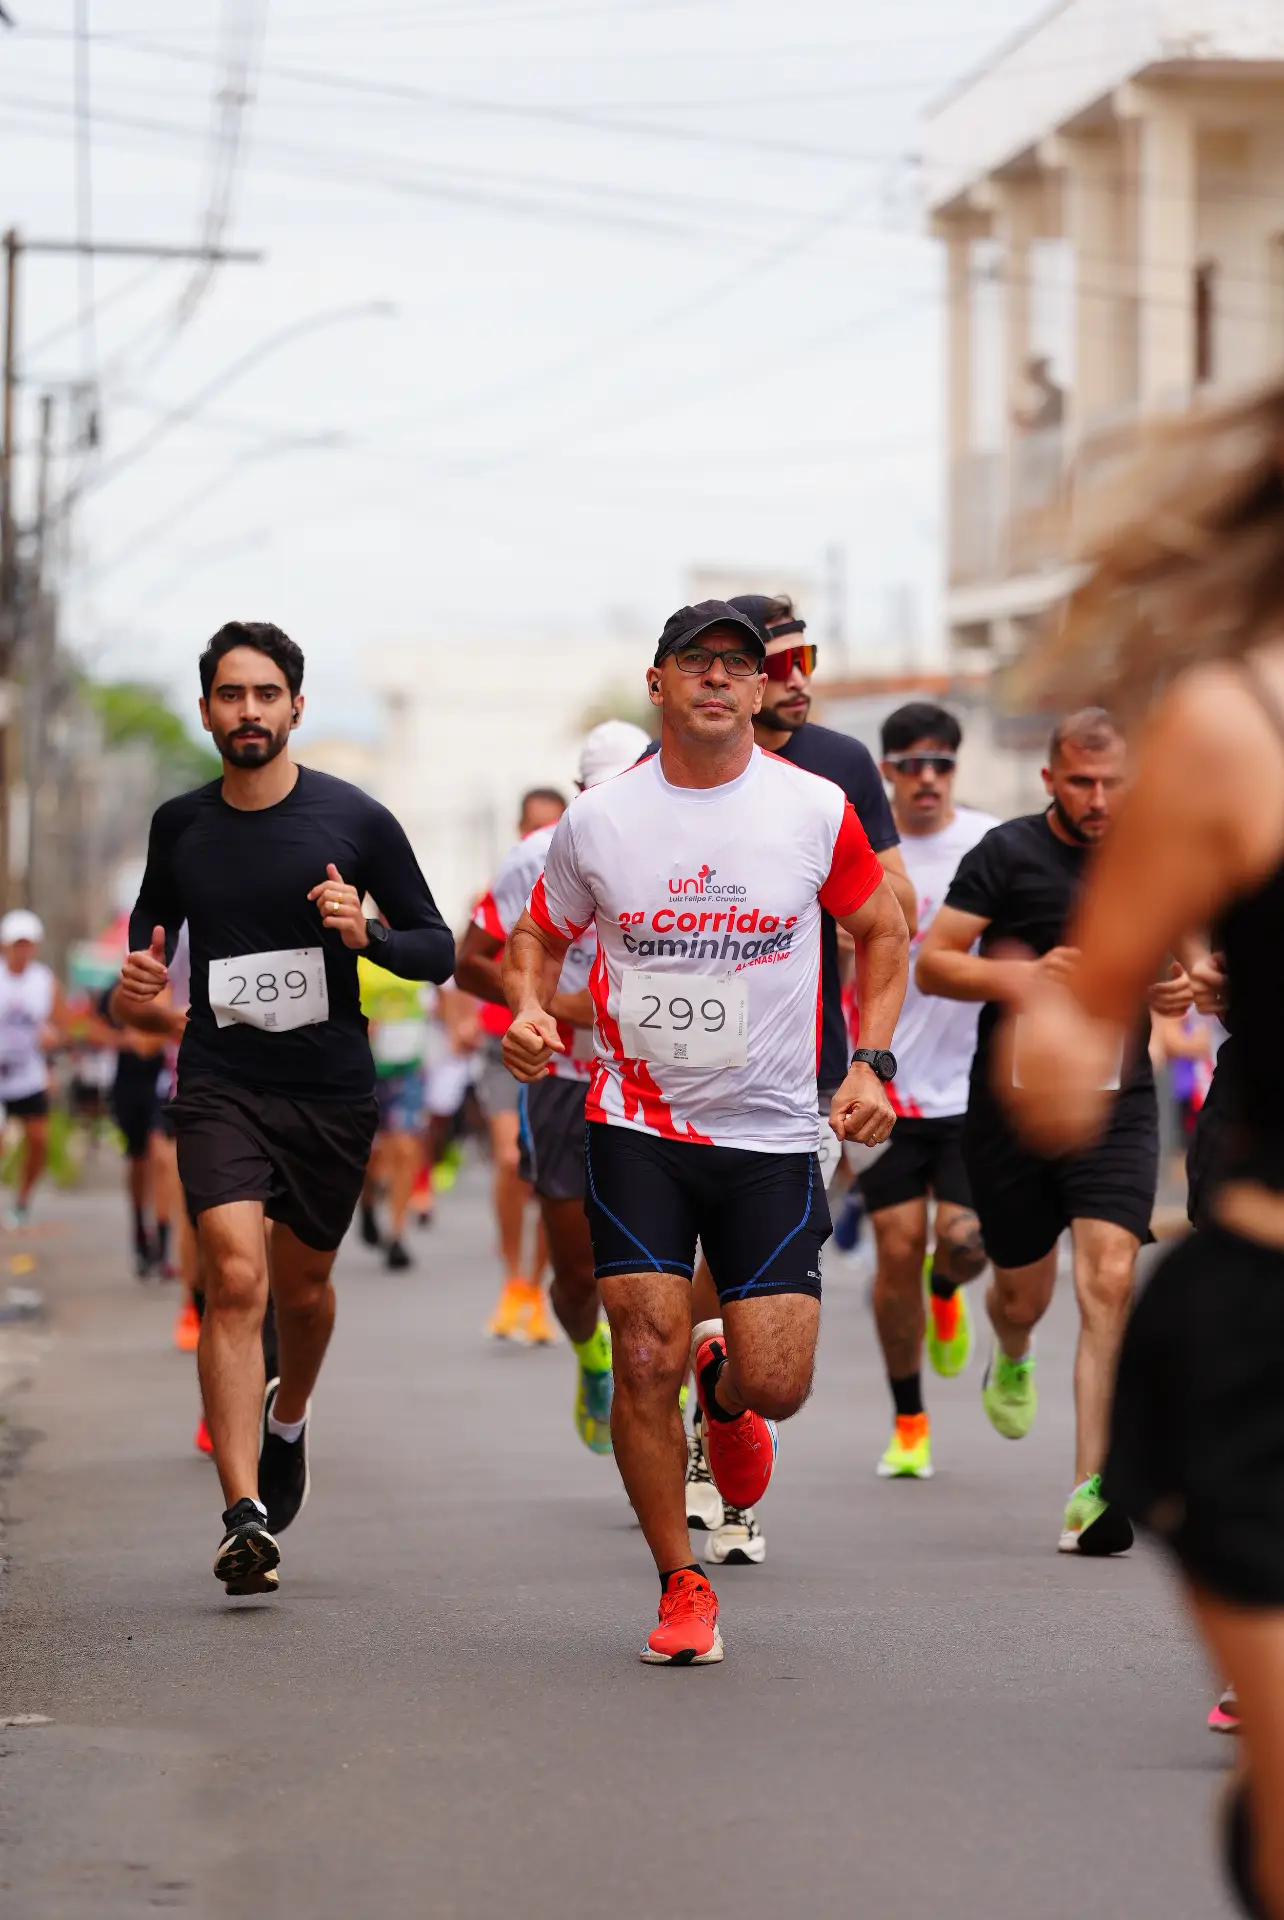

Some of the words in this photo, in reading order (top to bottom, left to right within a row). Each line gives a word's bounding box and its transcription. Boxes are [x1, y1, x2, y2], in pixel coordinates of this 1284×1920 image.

[684, 895, 707, 904] Felipe
[651, 905, 780, 934] Corrida
[622, 932, 795, 961] Caminhada
[228, 970, 308, 1006] 289
[638, 995, 727, 1033] 299
